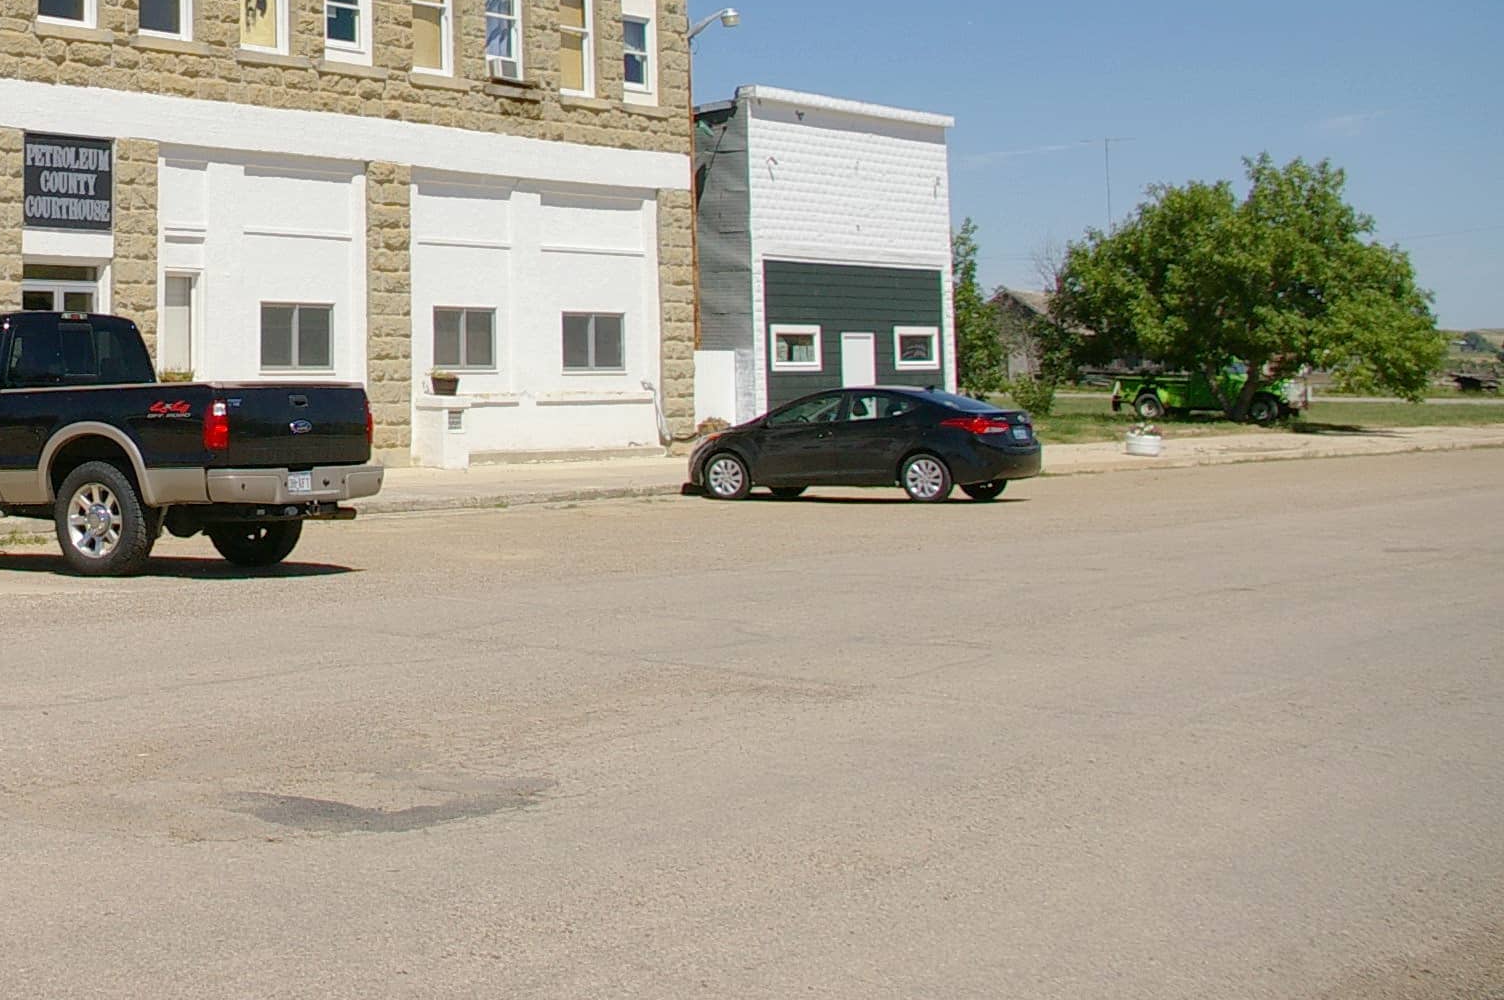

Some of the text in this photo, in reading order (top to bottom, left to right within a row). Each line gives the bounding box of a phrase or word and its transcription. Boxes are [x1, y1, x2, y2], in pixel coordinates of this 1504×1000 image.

[26, 144, 110, 171] PETROLEUM
[40, 171, 98, 195] COUNTY
[25, 195, 110, 221] COURTHOUSE
